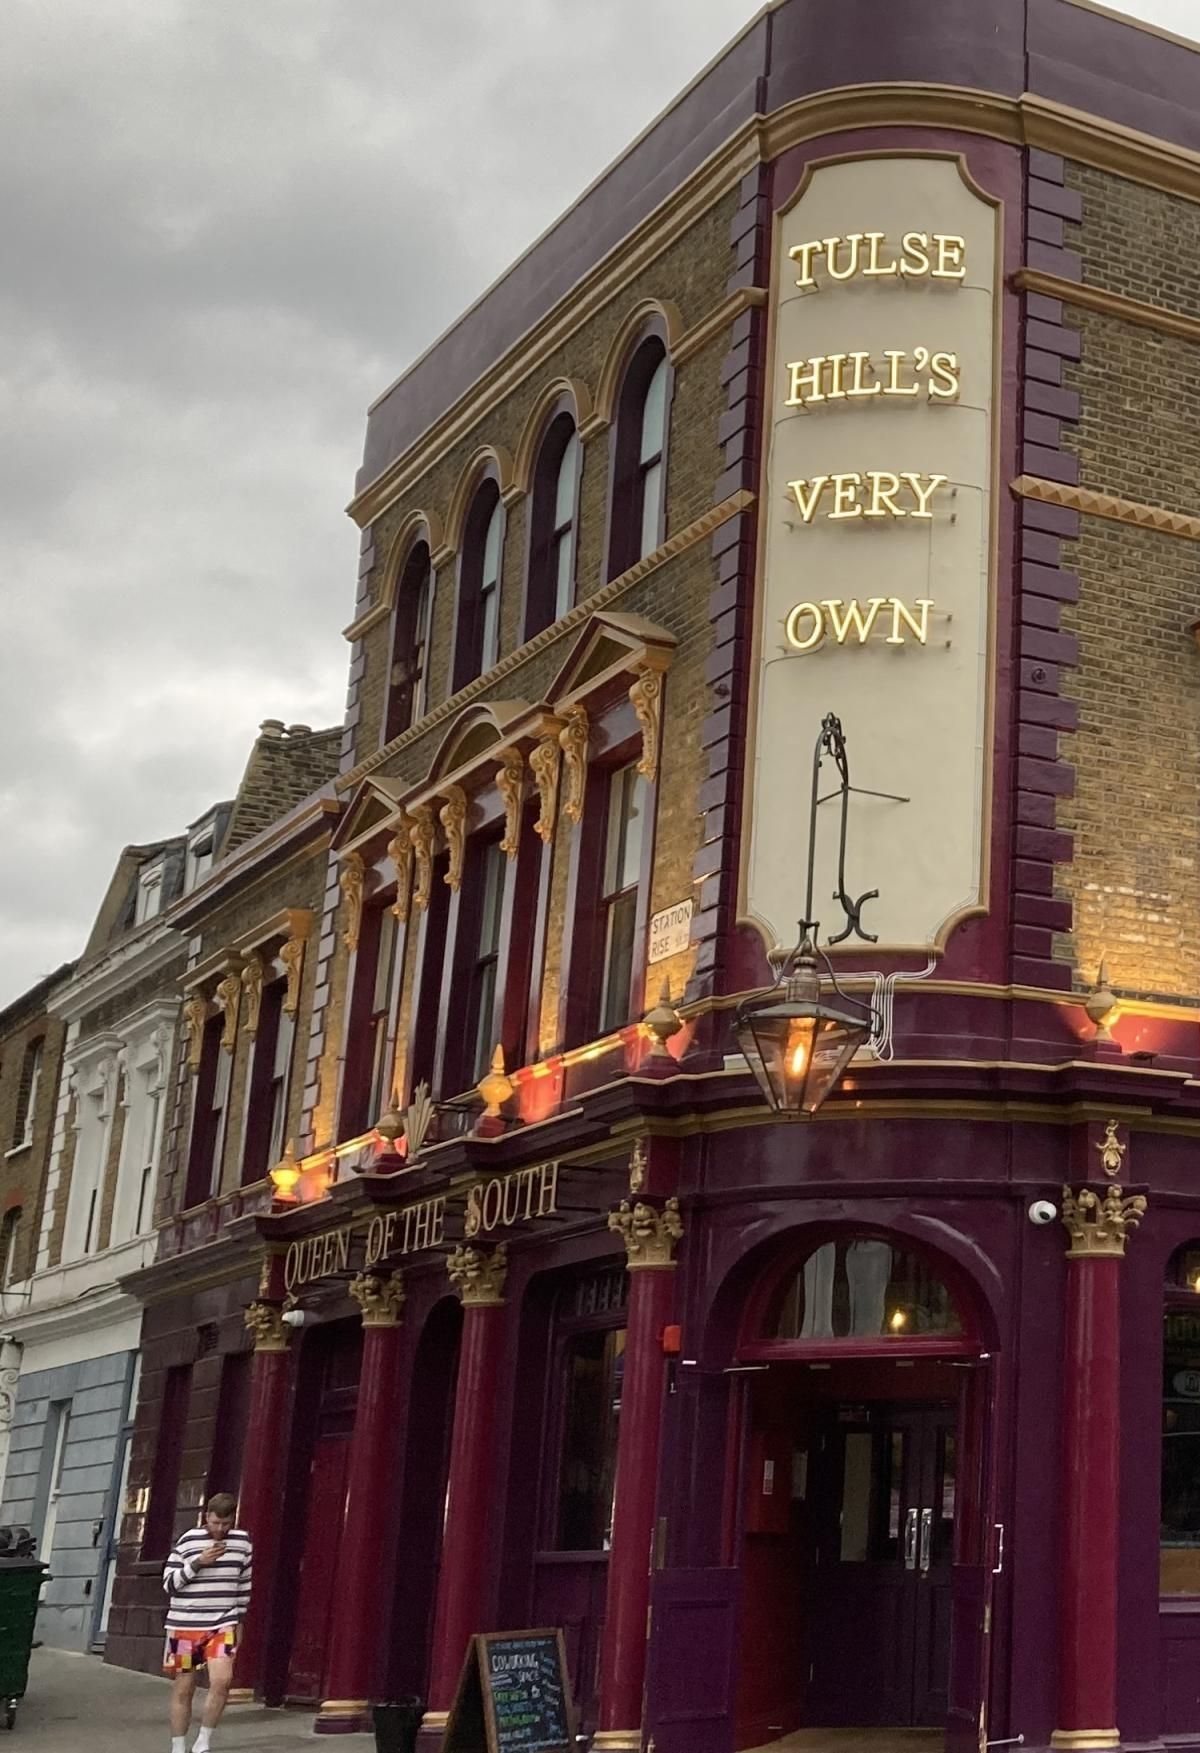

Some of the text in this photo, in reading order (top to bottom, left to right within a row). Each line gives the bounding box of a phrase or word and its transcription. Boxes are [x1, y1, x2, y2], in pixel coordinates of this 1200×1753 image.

[789, 232, 966, 288] TULSE
[785, 347, 960, 406] HILL'S
[787, 471, 948, 524] VERY
[785, 598, 935, 649] OWN
[653, 906, 690, 934] STATION
[651, 936, 670, 958] RISE
[284, 1160, 562, 1302] QUEEN OF THE SOUTH
